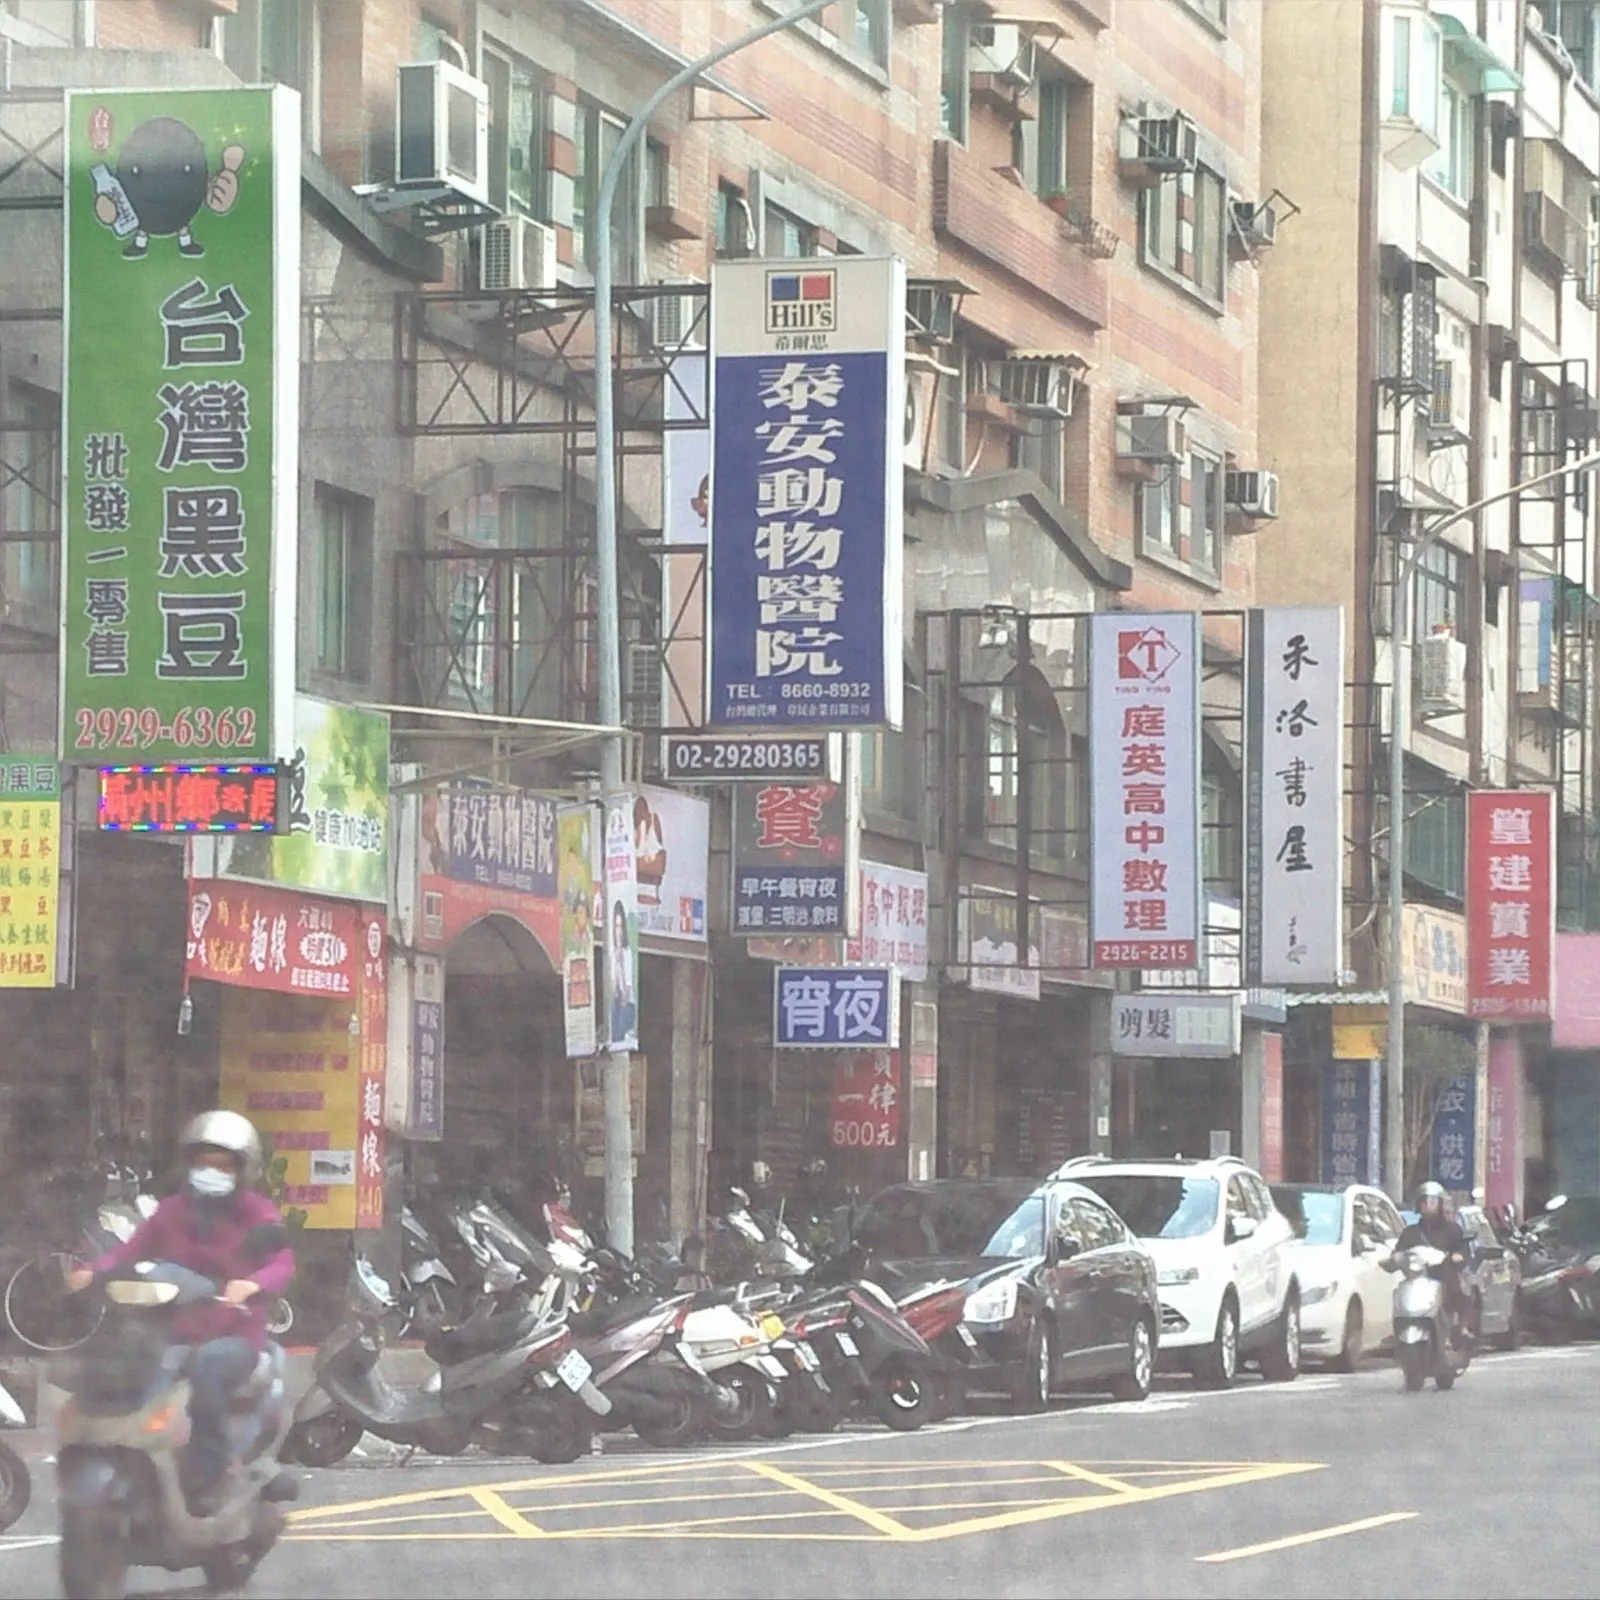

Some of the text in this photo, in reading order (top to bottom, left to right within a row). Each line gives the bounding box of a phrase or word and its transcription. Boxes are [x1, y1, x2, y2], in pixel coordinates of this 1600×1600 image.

[770, 304, 833, 328] Hill's
[775, 333, 828, 351] 希爾思
[156, 276, 251, 680] 台灣黑豆
[754, 361, 845, 678] 泰安動物醫院
[780, 682, 871, 699] 8660-8932
[76, 707, 256, 748] 2929-6362
[675, 743, 820, 769] 02-29280365
[1276, 634, 1319, 873] 禾洛書屋
[452, 784, 553, 874] 泰安動物醫院
[756, 784, 822, 848] 餐
[1121, 704, 1168, 932] 庭英高中數理
[740, 876, 838, 899] 早午餐宵夜
[1100, 946, 1188, 962] 2926-2215
[781, 974, 884, 1039] 宵夜
[1119, 1008, 1172, 1039] 剪髮
[837, 1080, 898, 1116] 一律
[832, 1120, 897, 1147] 500元
